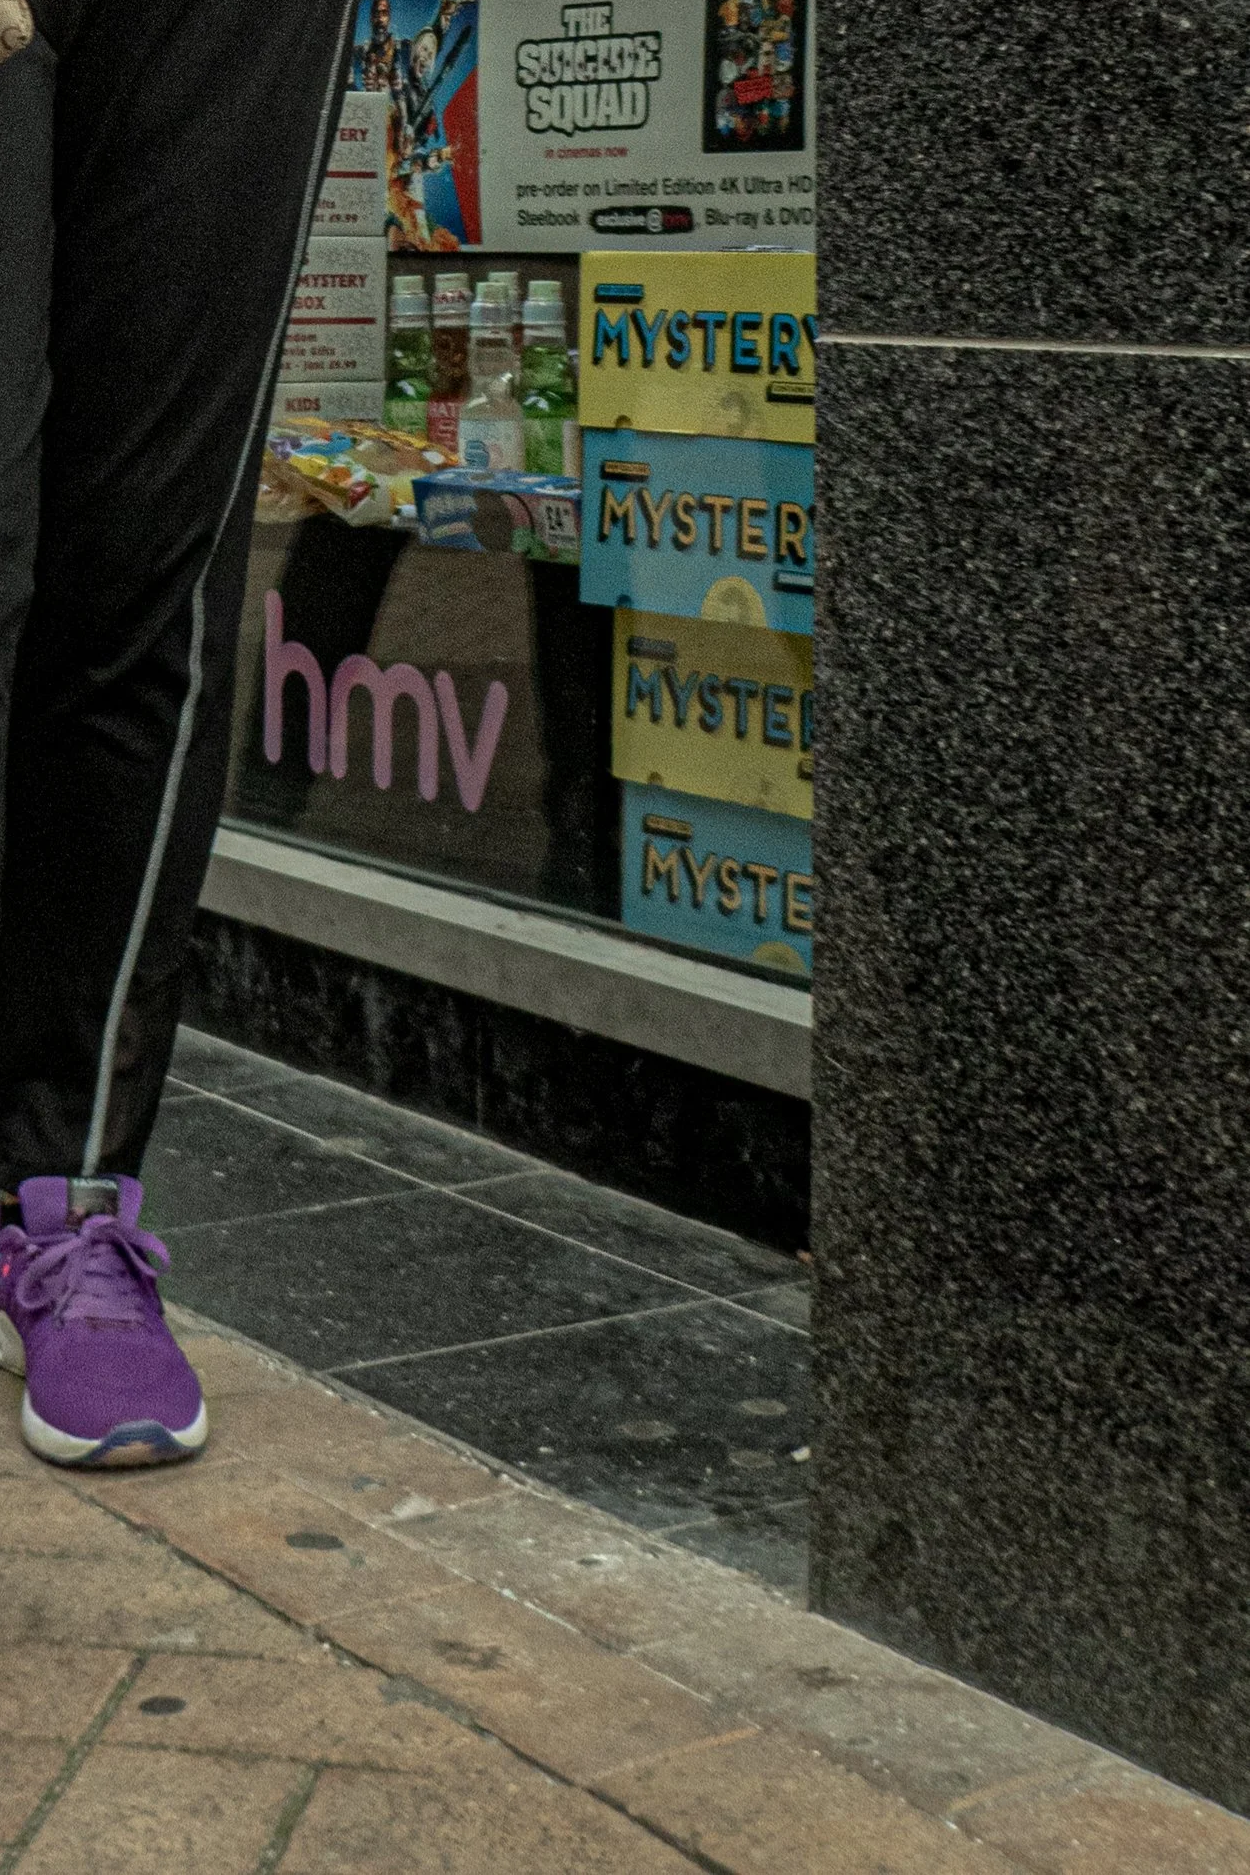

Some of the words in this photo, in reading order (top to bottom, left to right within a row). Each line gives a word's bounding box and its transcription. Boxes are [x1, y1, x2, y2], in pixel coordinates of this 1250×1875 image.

[561, 1, 613, 38] THE
[516, 31, 662, 88] SUICIDE
[527, 82, 649, 137] SQUAD
[516, 180, 579, 200] pre-order
[583, 182, 600, 196] on
[605, 178, 658, 196] Limited
[663, 177, 716, 196] Edition
[719, 177, 739, 194] 4K
[743, 177, 783, 195] Ultra
[787, 176, 814, 194] HD
[517, 208, 580, 226] Steelbook
[705, 208, 758, 229] Blu-ray
[765, 208, 775, 225] &
[778, 207, 814, 225] DVD
[285, 397, 321, 413] KIDS
[598, 484, 817, 566] MYSTER
[264, 589, 508, 812] hmv
